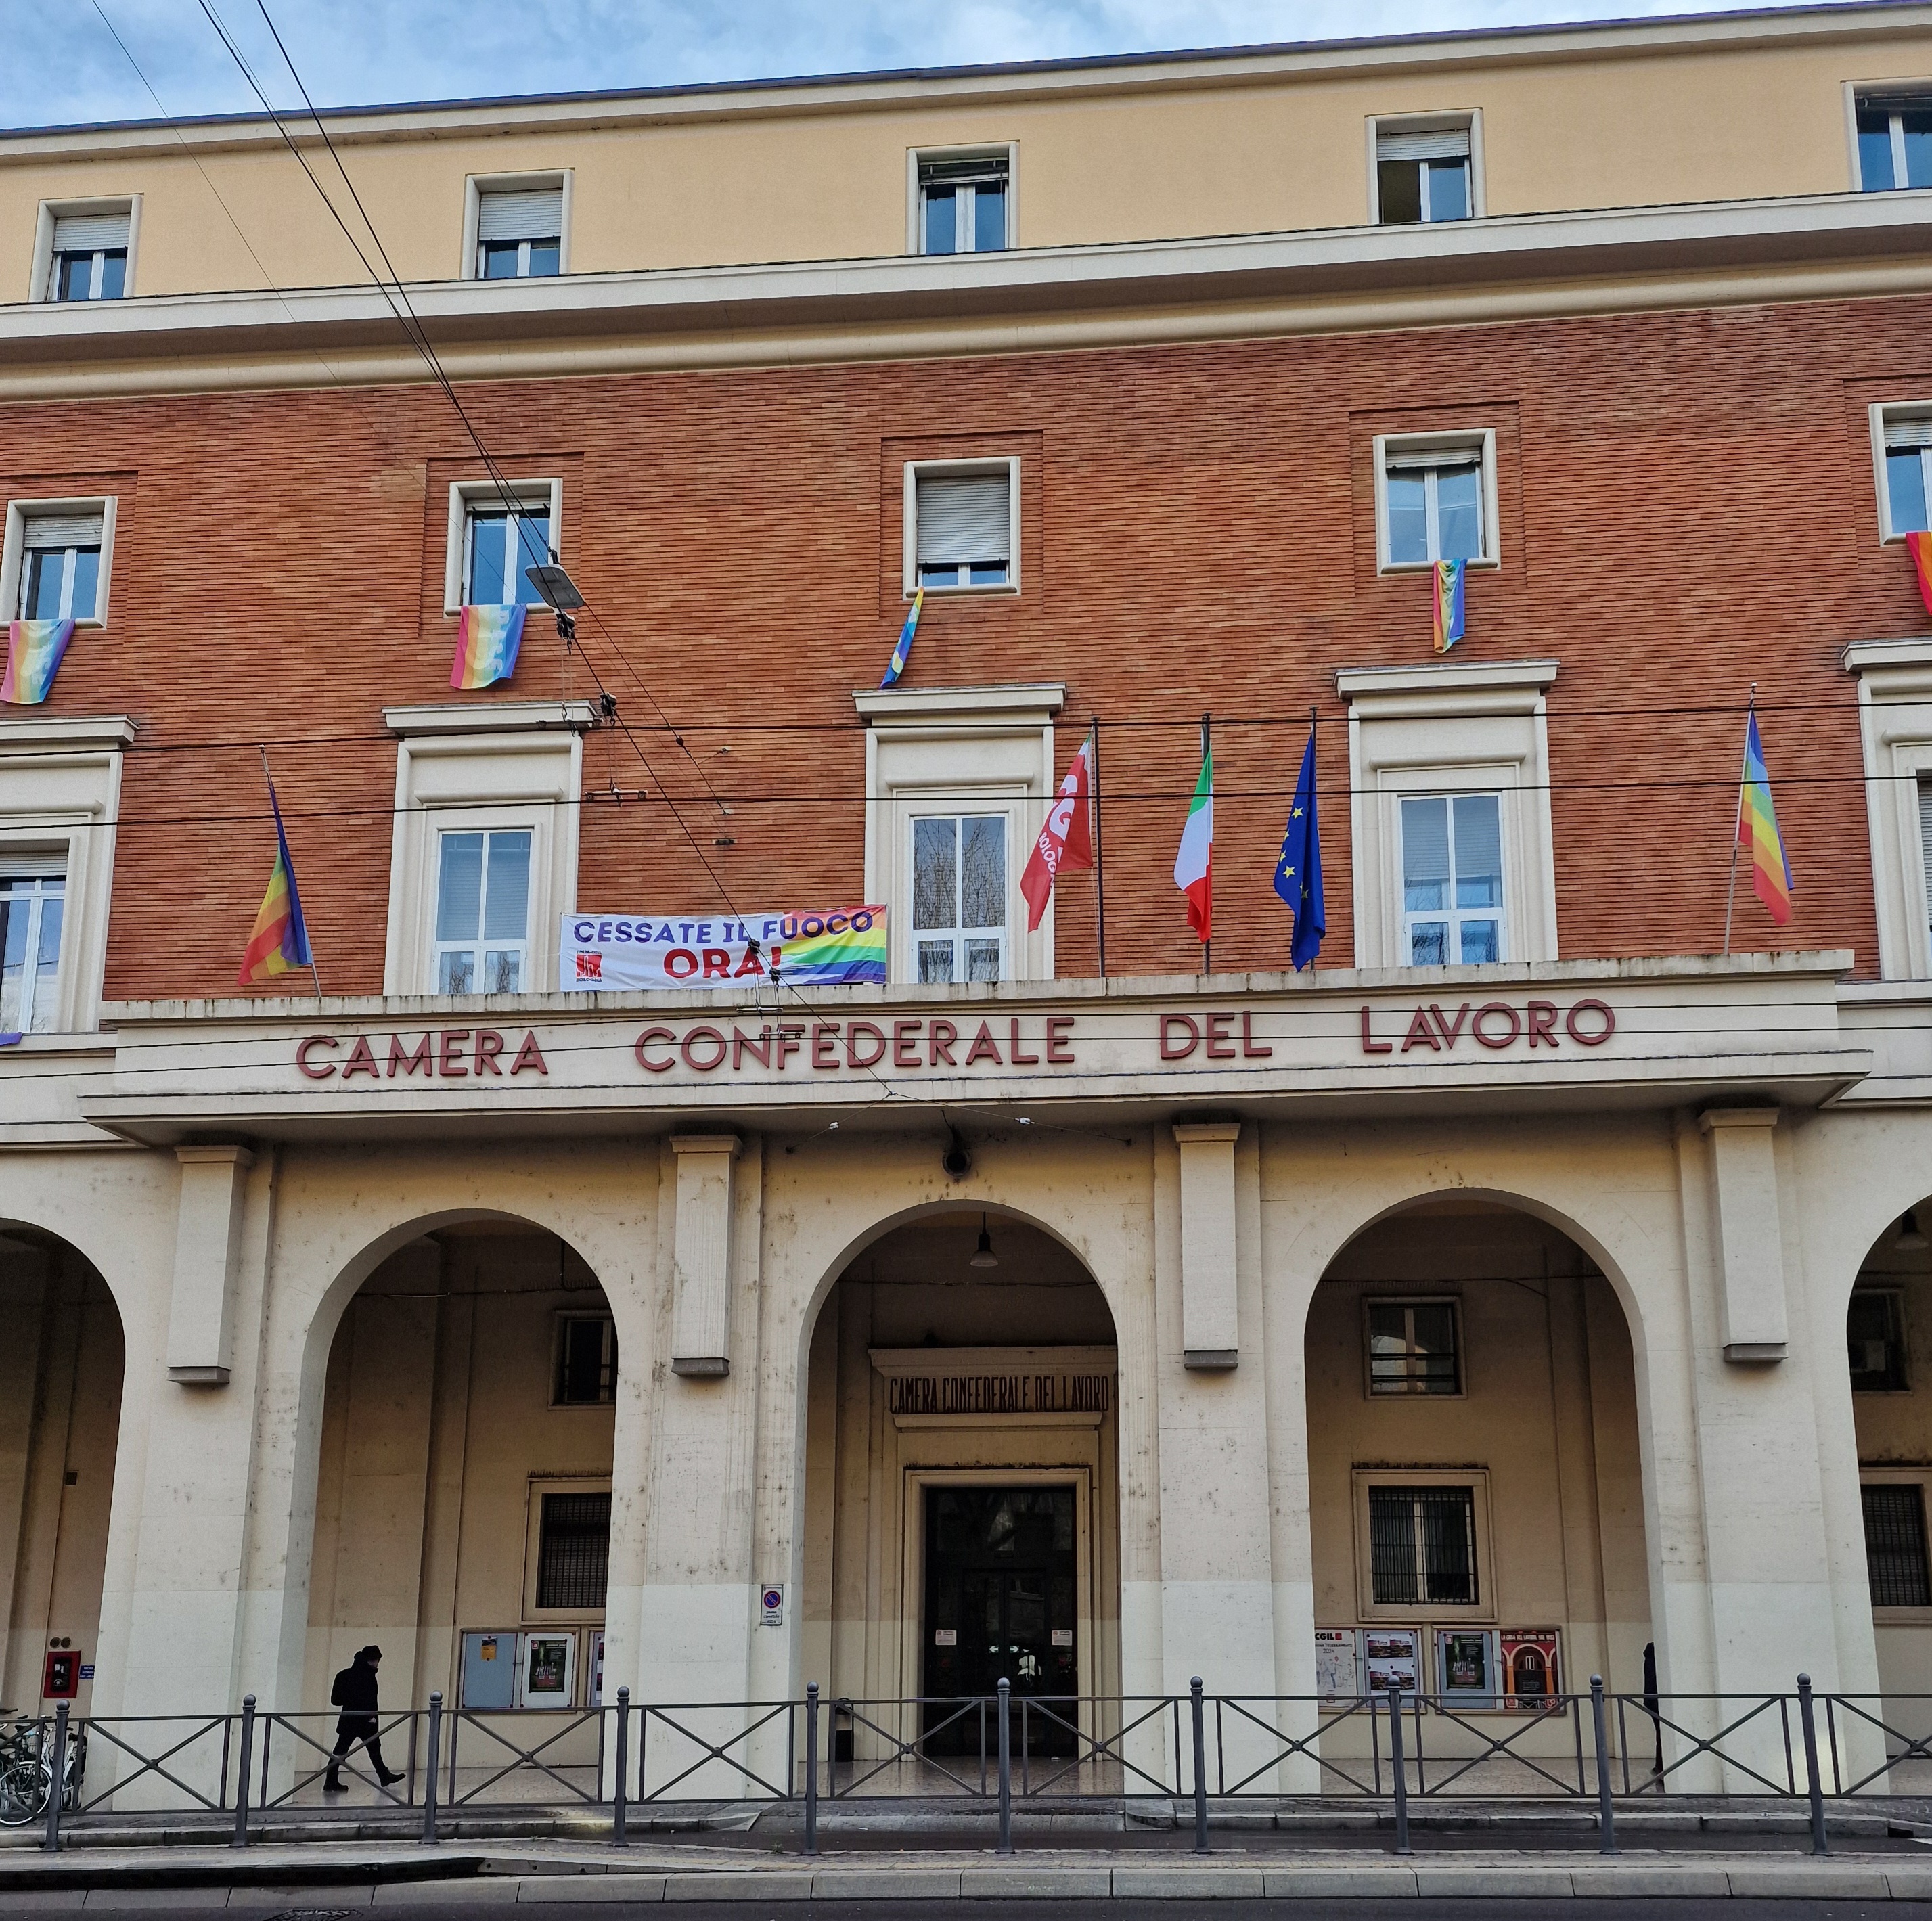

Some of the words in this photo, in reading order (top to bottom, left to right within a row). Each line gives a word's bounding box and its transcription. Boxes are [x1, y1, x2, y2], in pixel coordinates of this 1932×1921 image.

[574, 922, 711, 943] CESSATE
[722, 922, 750, 943] IL
[763, 911, 873, 939] FUOCO
[296, 1029, 549, 1079] CAMERA
[634, 1016, 1075, 1072] CONFEDERALE
[1159, 1010, 1273, 1060] DEL
[1361, 998, 1616, 1054] LAVORO
[890, 1377, 939, 1414] CAMERA
[942, 1376, 1030, 1413] CONFEDERALE
[1035, 1376, 1056, 1412] DEL
[1062, 1375, 1109, 1412] LAVORO
